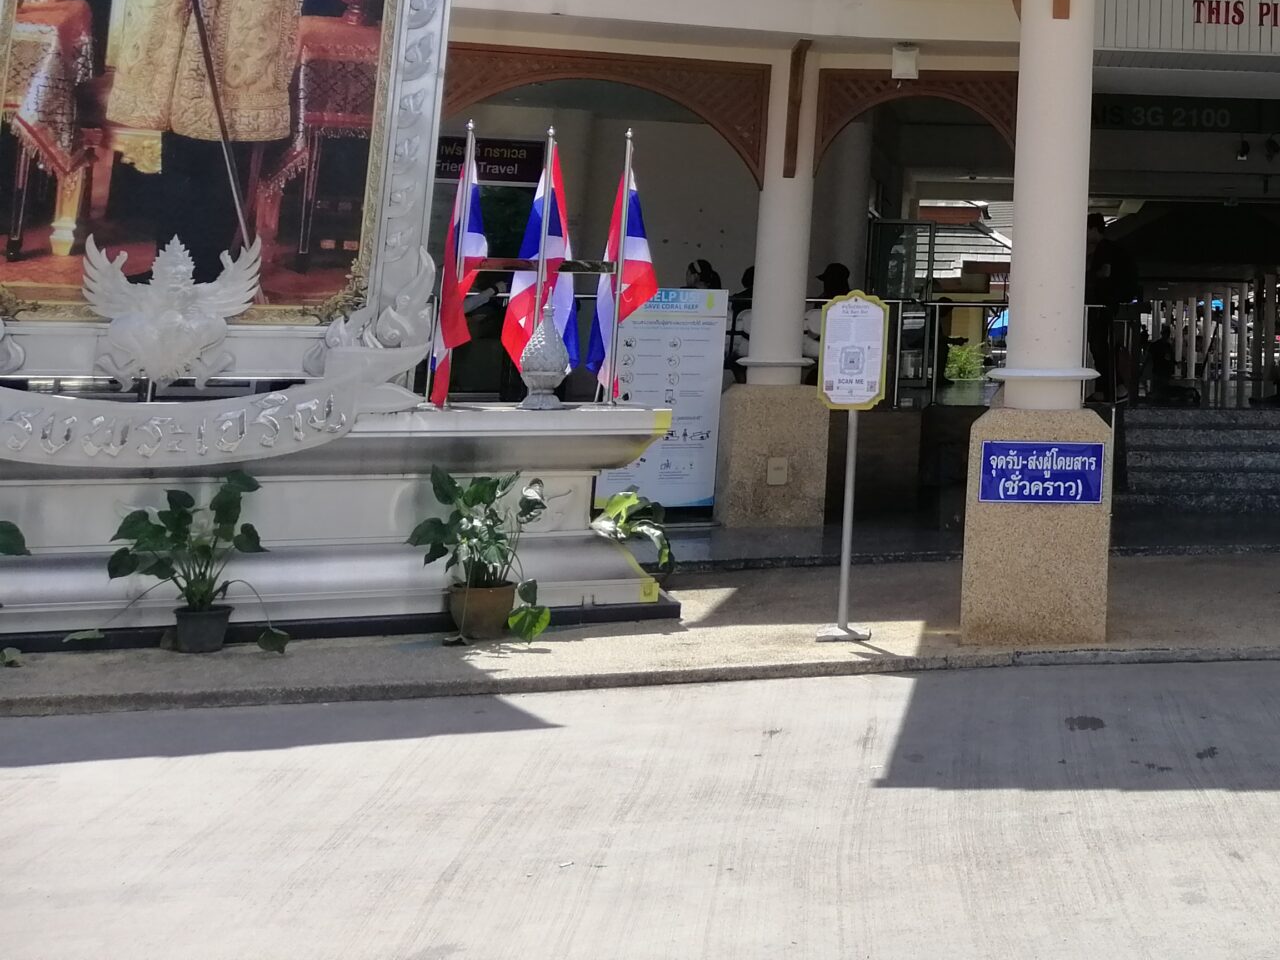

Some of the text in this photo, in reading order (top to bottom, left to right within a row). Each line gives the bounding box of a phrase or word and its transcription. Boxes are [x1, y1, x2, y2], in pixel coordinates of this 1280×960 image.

[1193, 0, 1245, 26] THIS
[1131, 105, 1166, 126] 3G
[1171, 107, 1232, 128] 2100
[478, 161, 518, 175] Travel
[650, 290, 678, 302] ELP
[661, 303, 682, 311] CORAL
[989, 448, 1097, 478] จุดรับ-ส่งผู้โดยสาร
[998, 471, 1083, 500] (ชั่วคราว)
